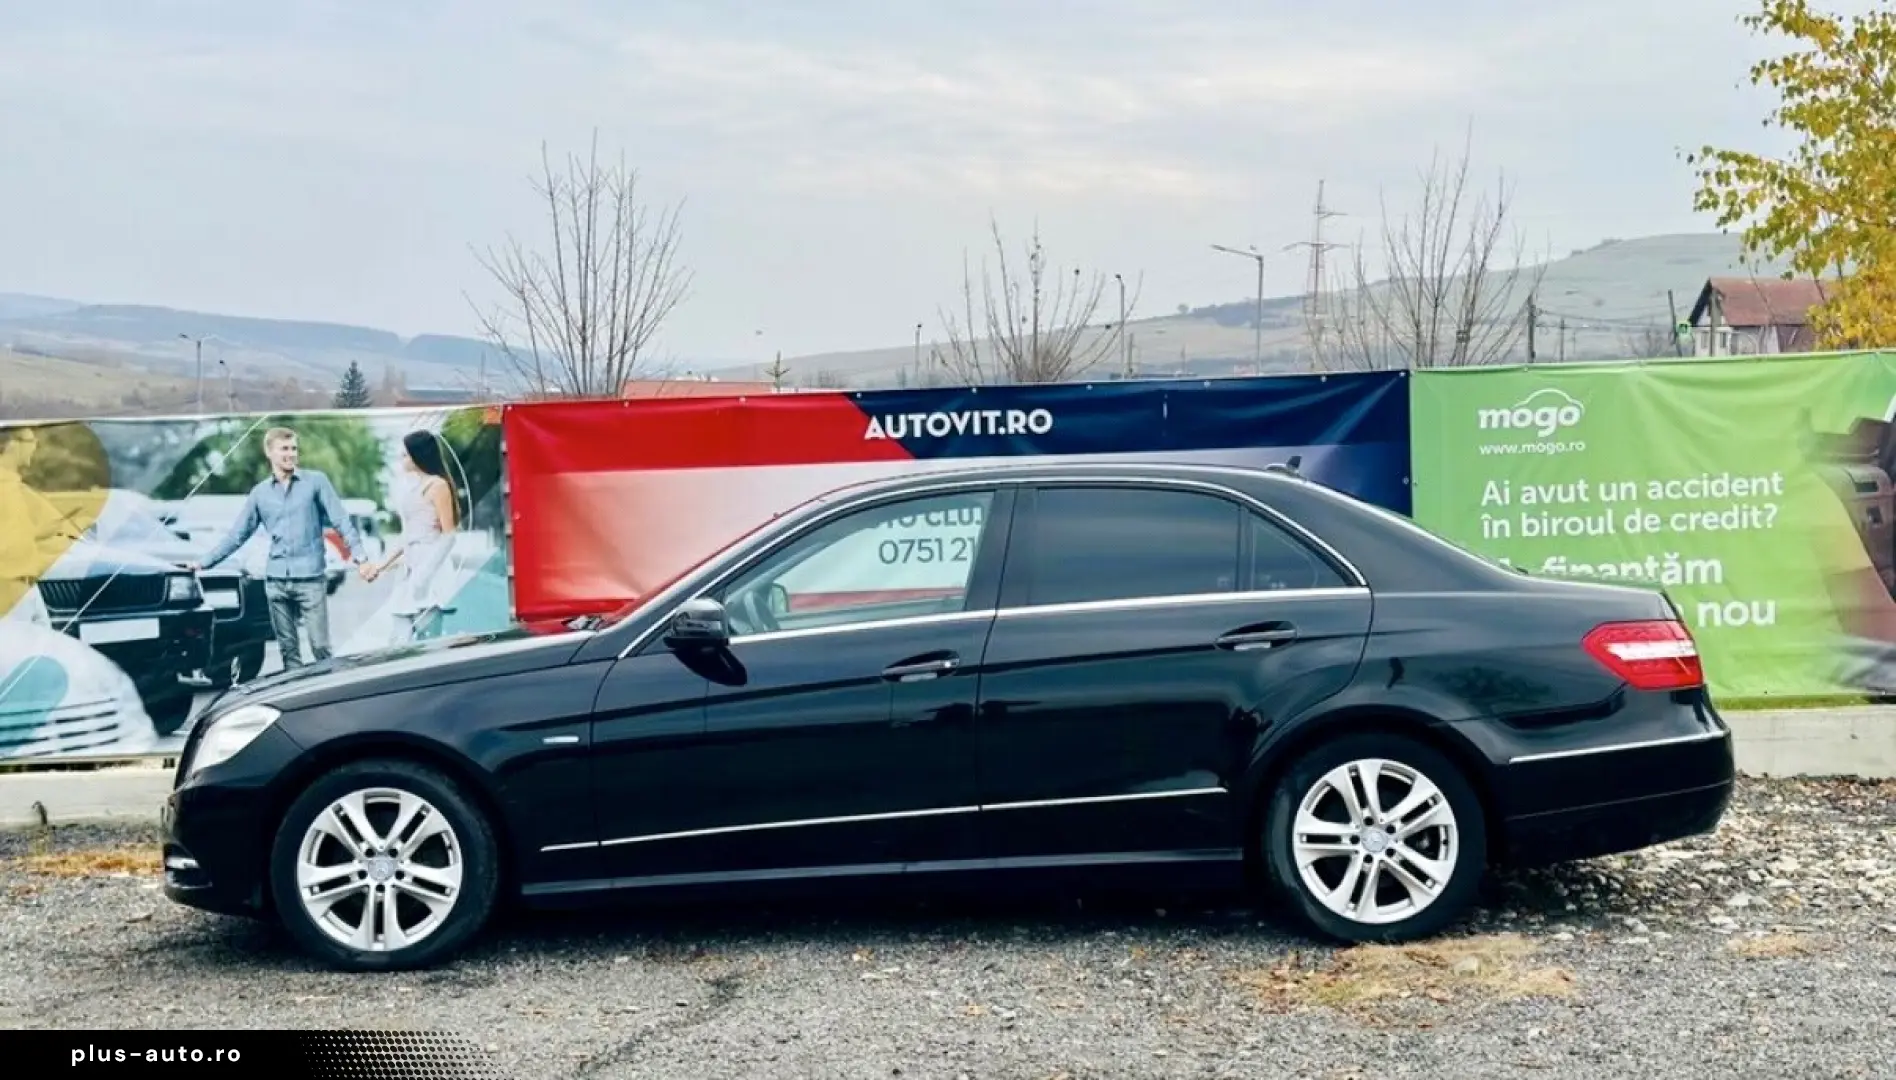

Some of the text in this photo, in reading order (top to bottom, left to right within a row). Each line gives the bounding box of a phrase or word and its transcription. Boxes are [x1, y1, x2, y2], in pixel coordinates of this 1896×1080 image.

[864, 408, 1054, 440] AUTOVIT.RO
[1478, 404, 1581, 438] mogo
[1480, 441, 1586, 455] www.mogo.ro
[1481, 471, 1784, 507] Ai avut un accident
[1481, 502, 1778, 539] în biroul de credit?
[879, 537, 943, 565] 0751
[1697, 599, 1776, 628] nou
